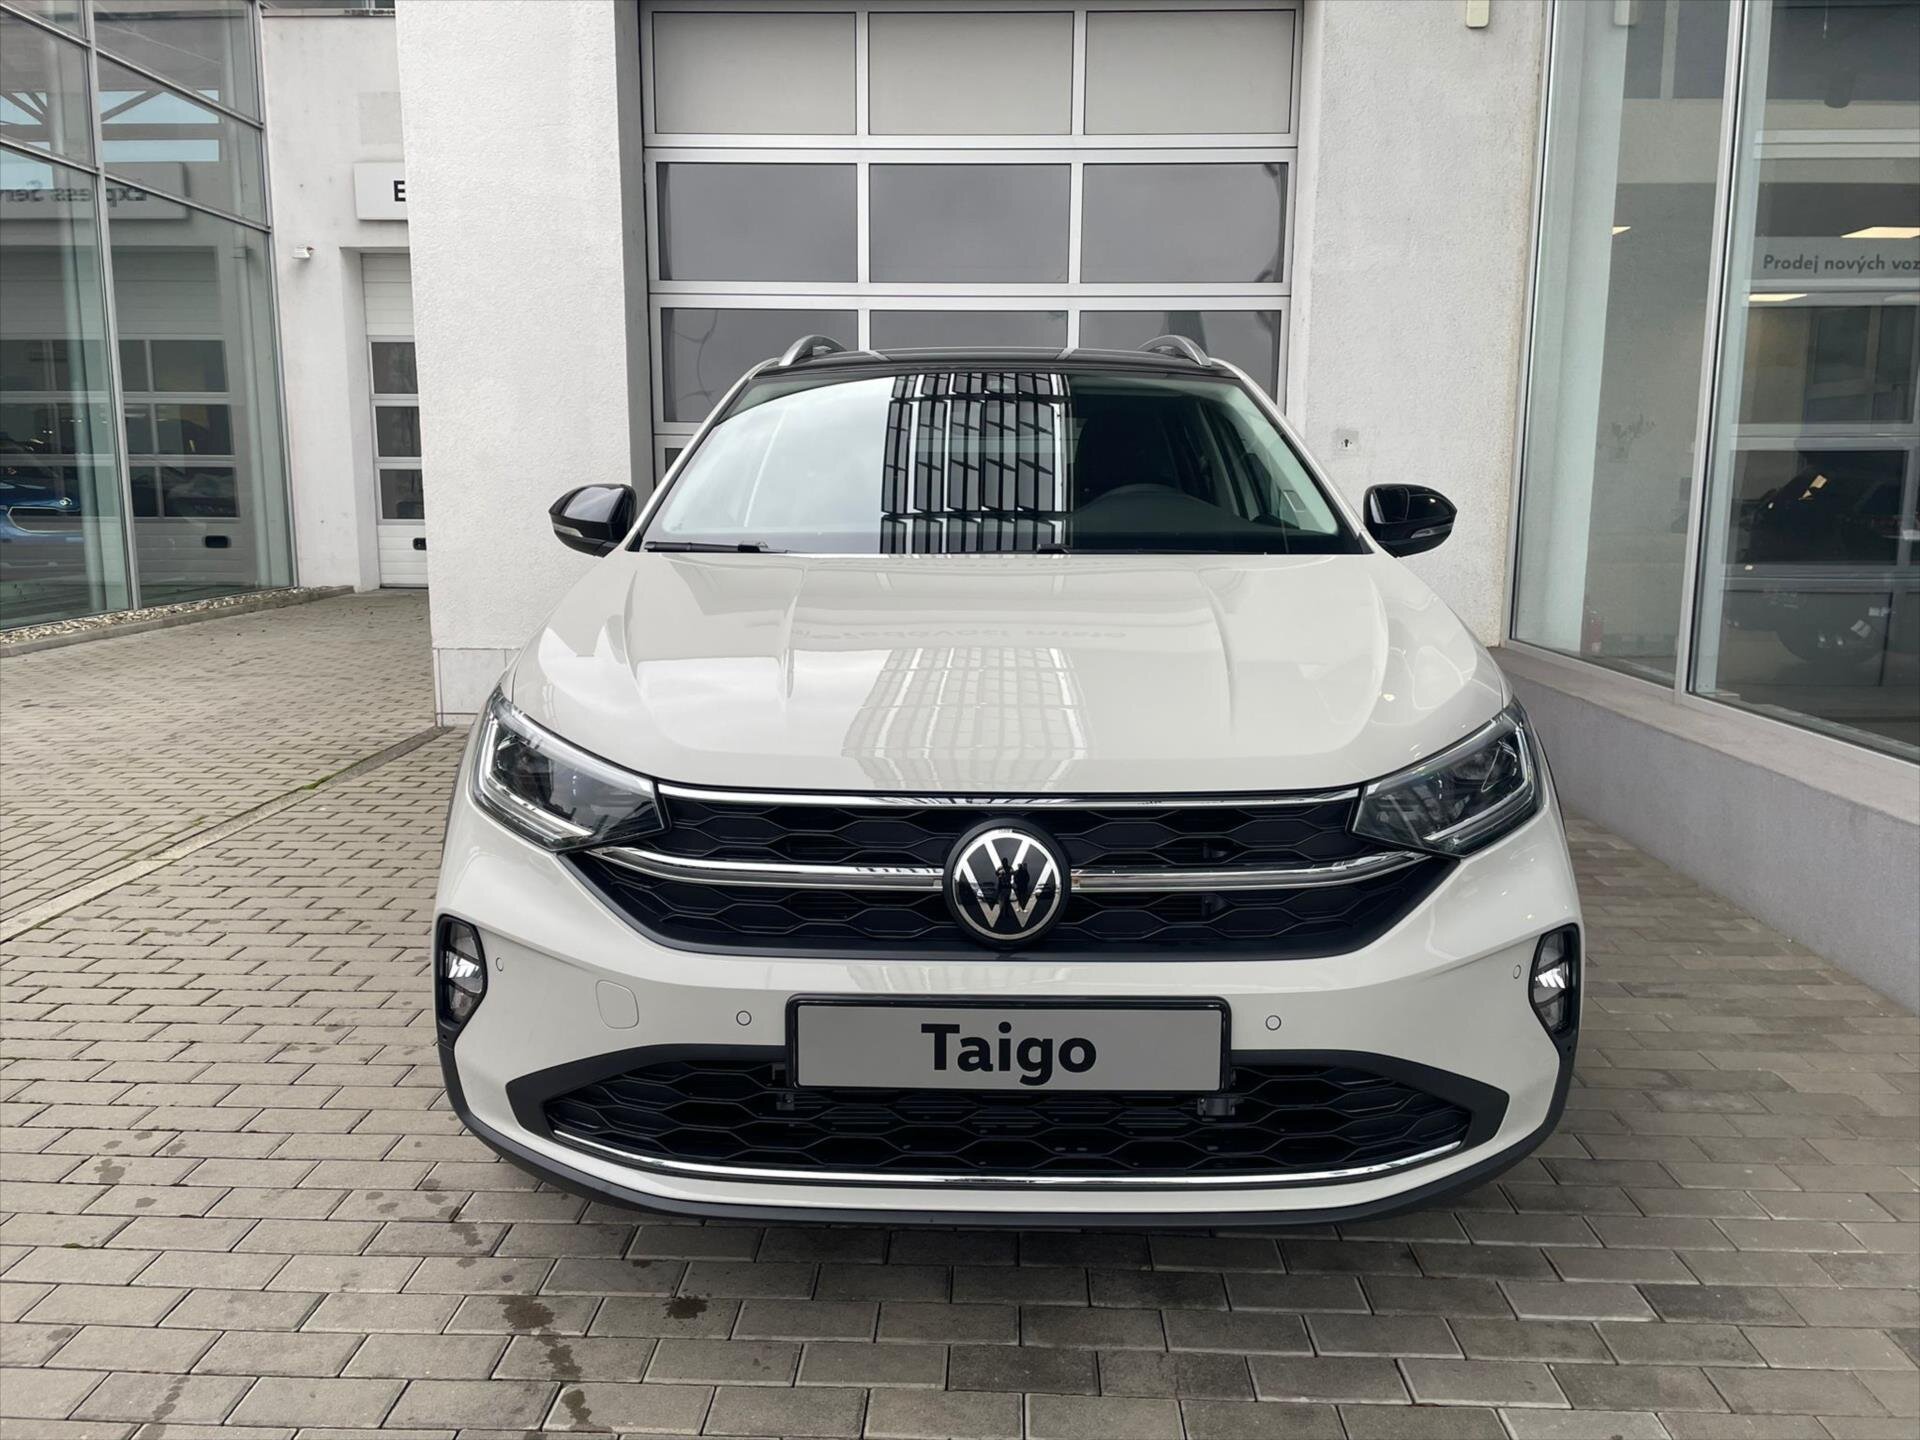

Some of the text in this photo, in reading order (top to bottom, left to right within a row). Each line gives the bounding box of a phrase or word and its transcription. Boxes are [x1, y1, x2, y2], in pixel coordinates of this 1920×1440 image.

[1763, 254, 1819, 274] Prodej
[1824, 254, 1886, 274] nových
[920, 1020, 1098, 1087] Taigo
